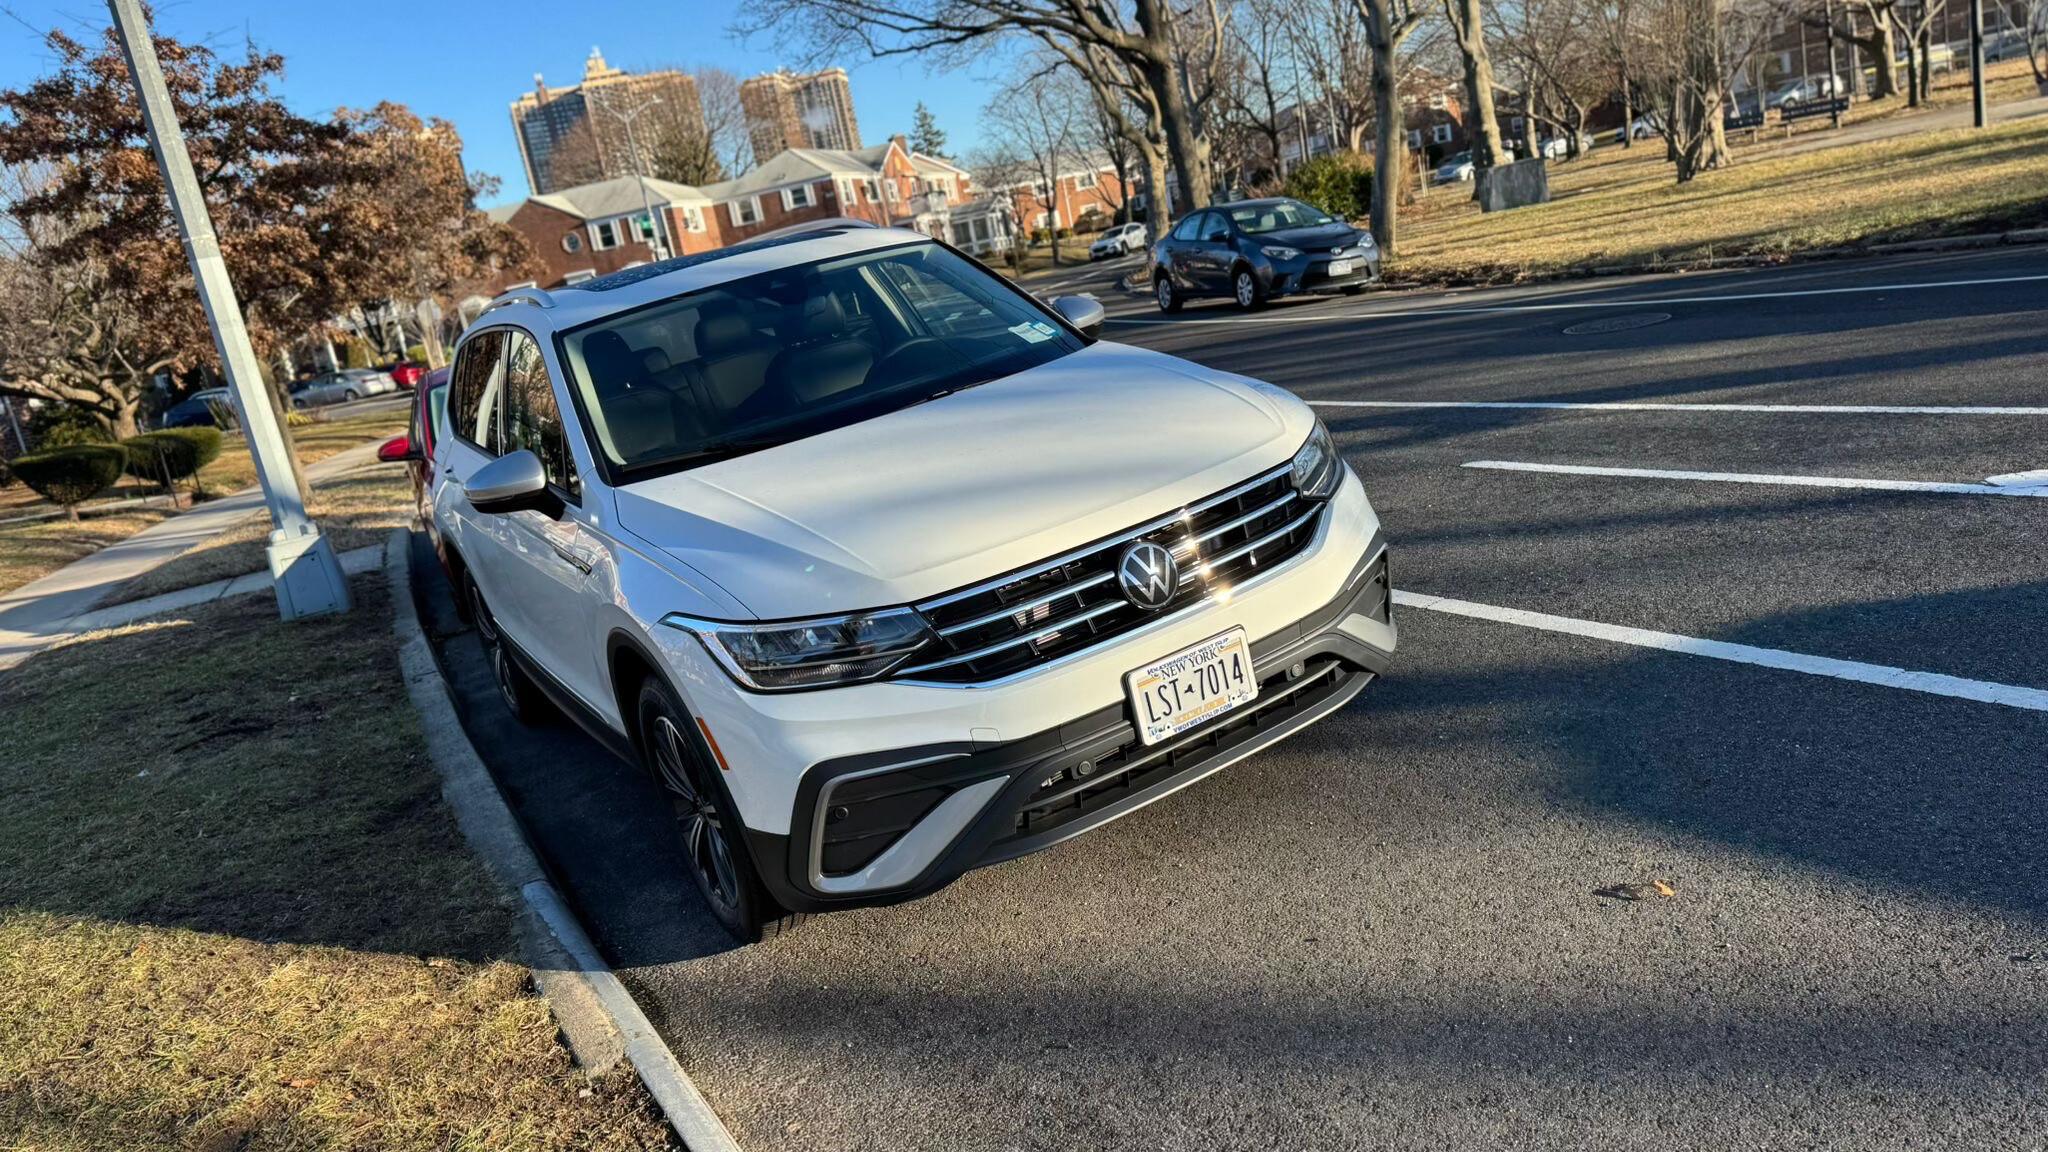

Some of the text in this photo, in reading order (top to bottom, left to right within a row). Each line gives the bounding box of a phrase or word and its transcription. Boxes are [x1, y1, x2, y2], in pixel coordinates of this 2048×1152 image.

[1122, 544, 1173, 605] VW
[1147, 655, 1188, 675] VOLKSWAGEN
[1198, 643, 1215, 654] WEST
[1161, 649, 1218, 680] NEW YORK
[1144, 678, 1182, 723] LST
[1194, 653, 1243, 701] 7014
